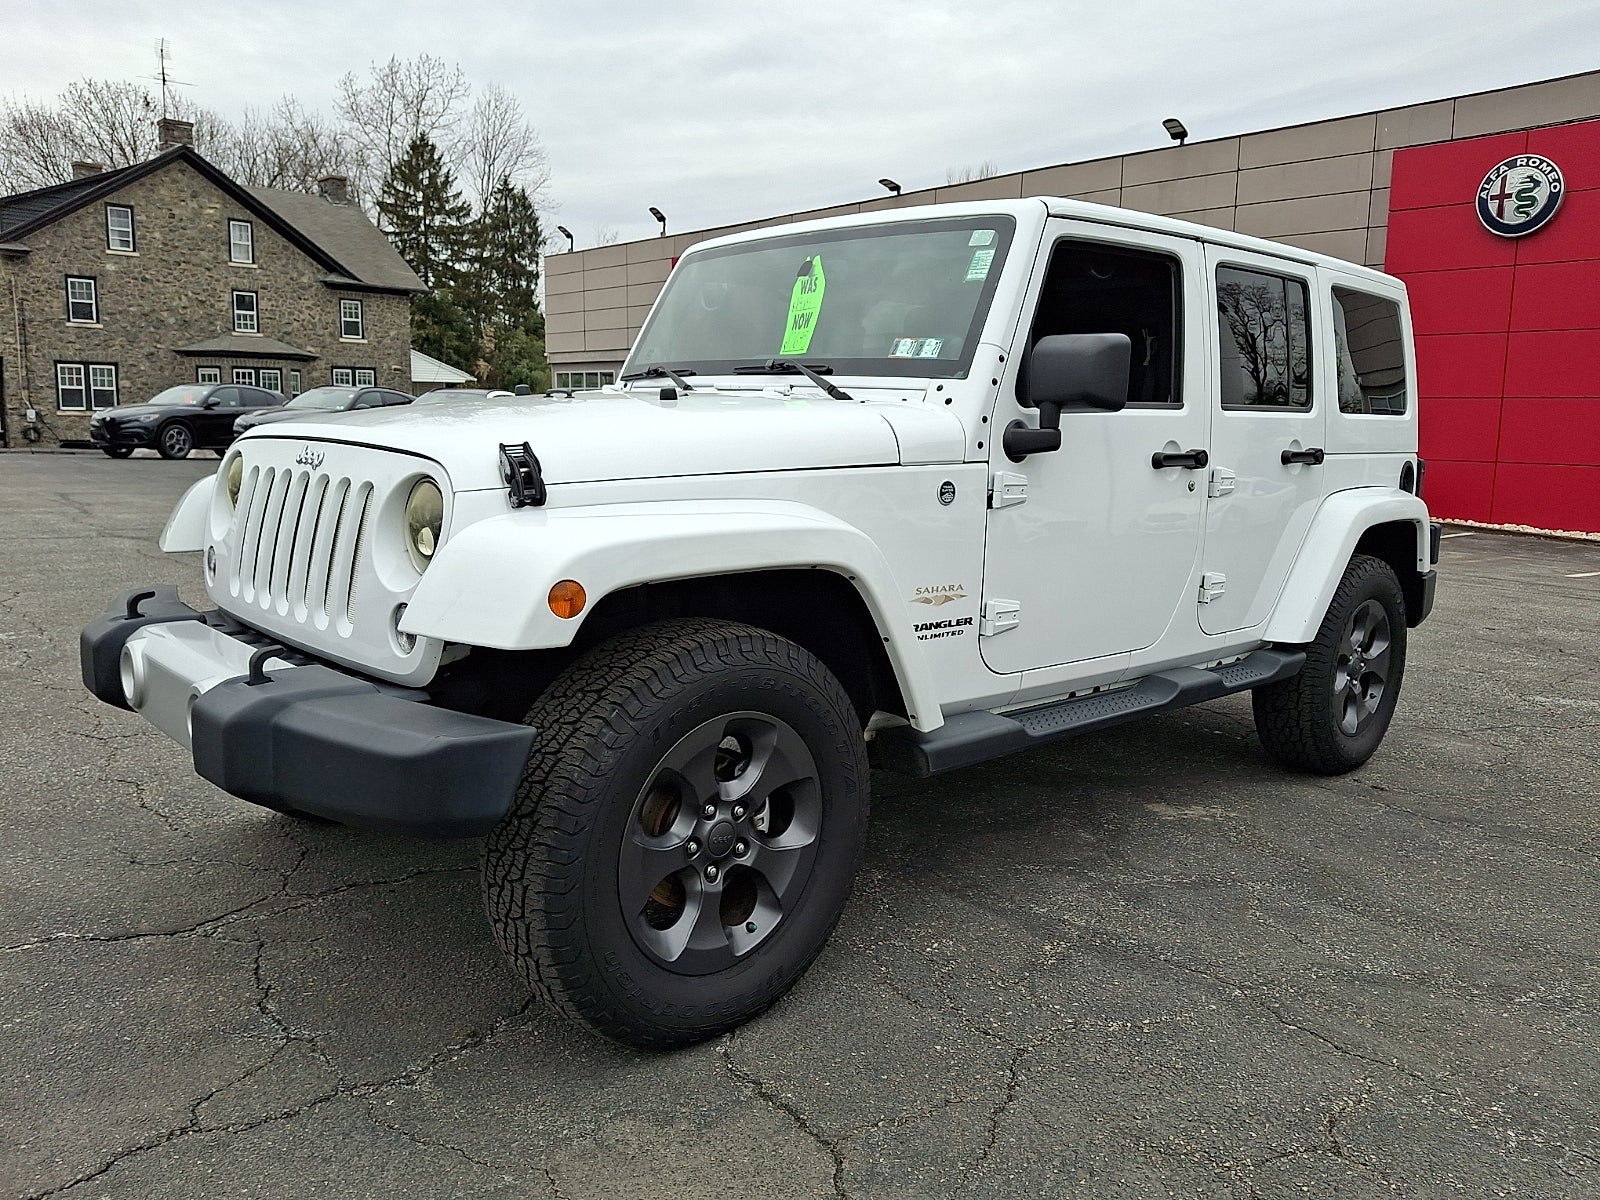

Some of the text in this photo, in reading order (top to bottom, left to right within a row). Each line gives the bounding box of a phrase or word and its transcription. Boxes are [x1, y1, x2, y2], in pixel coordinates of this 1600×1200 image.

[1480, 158, 1560, 199] ALFA ROMEO
[801, 277, 818, 295] WAS
[792, 312, 813, 330] NOW
[296, 443, 325, 470] Jeep
[915, 584, 964, 595] SAHARA
